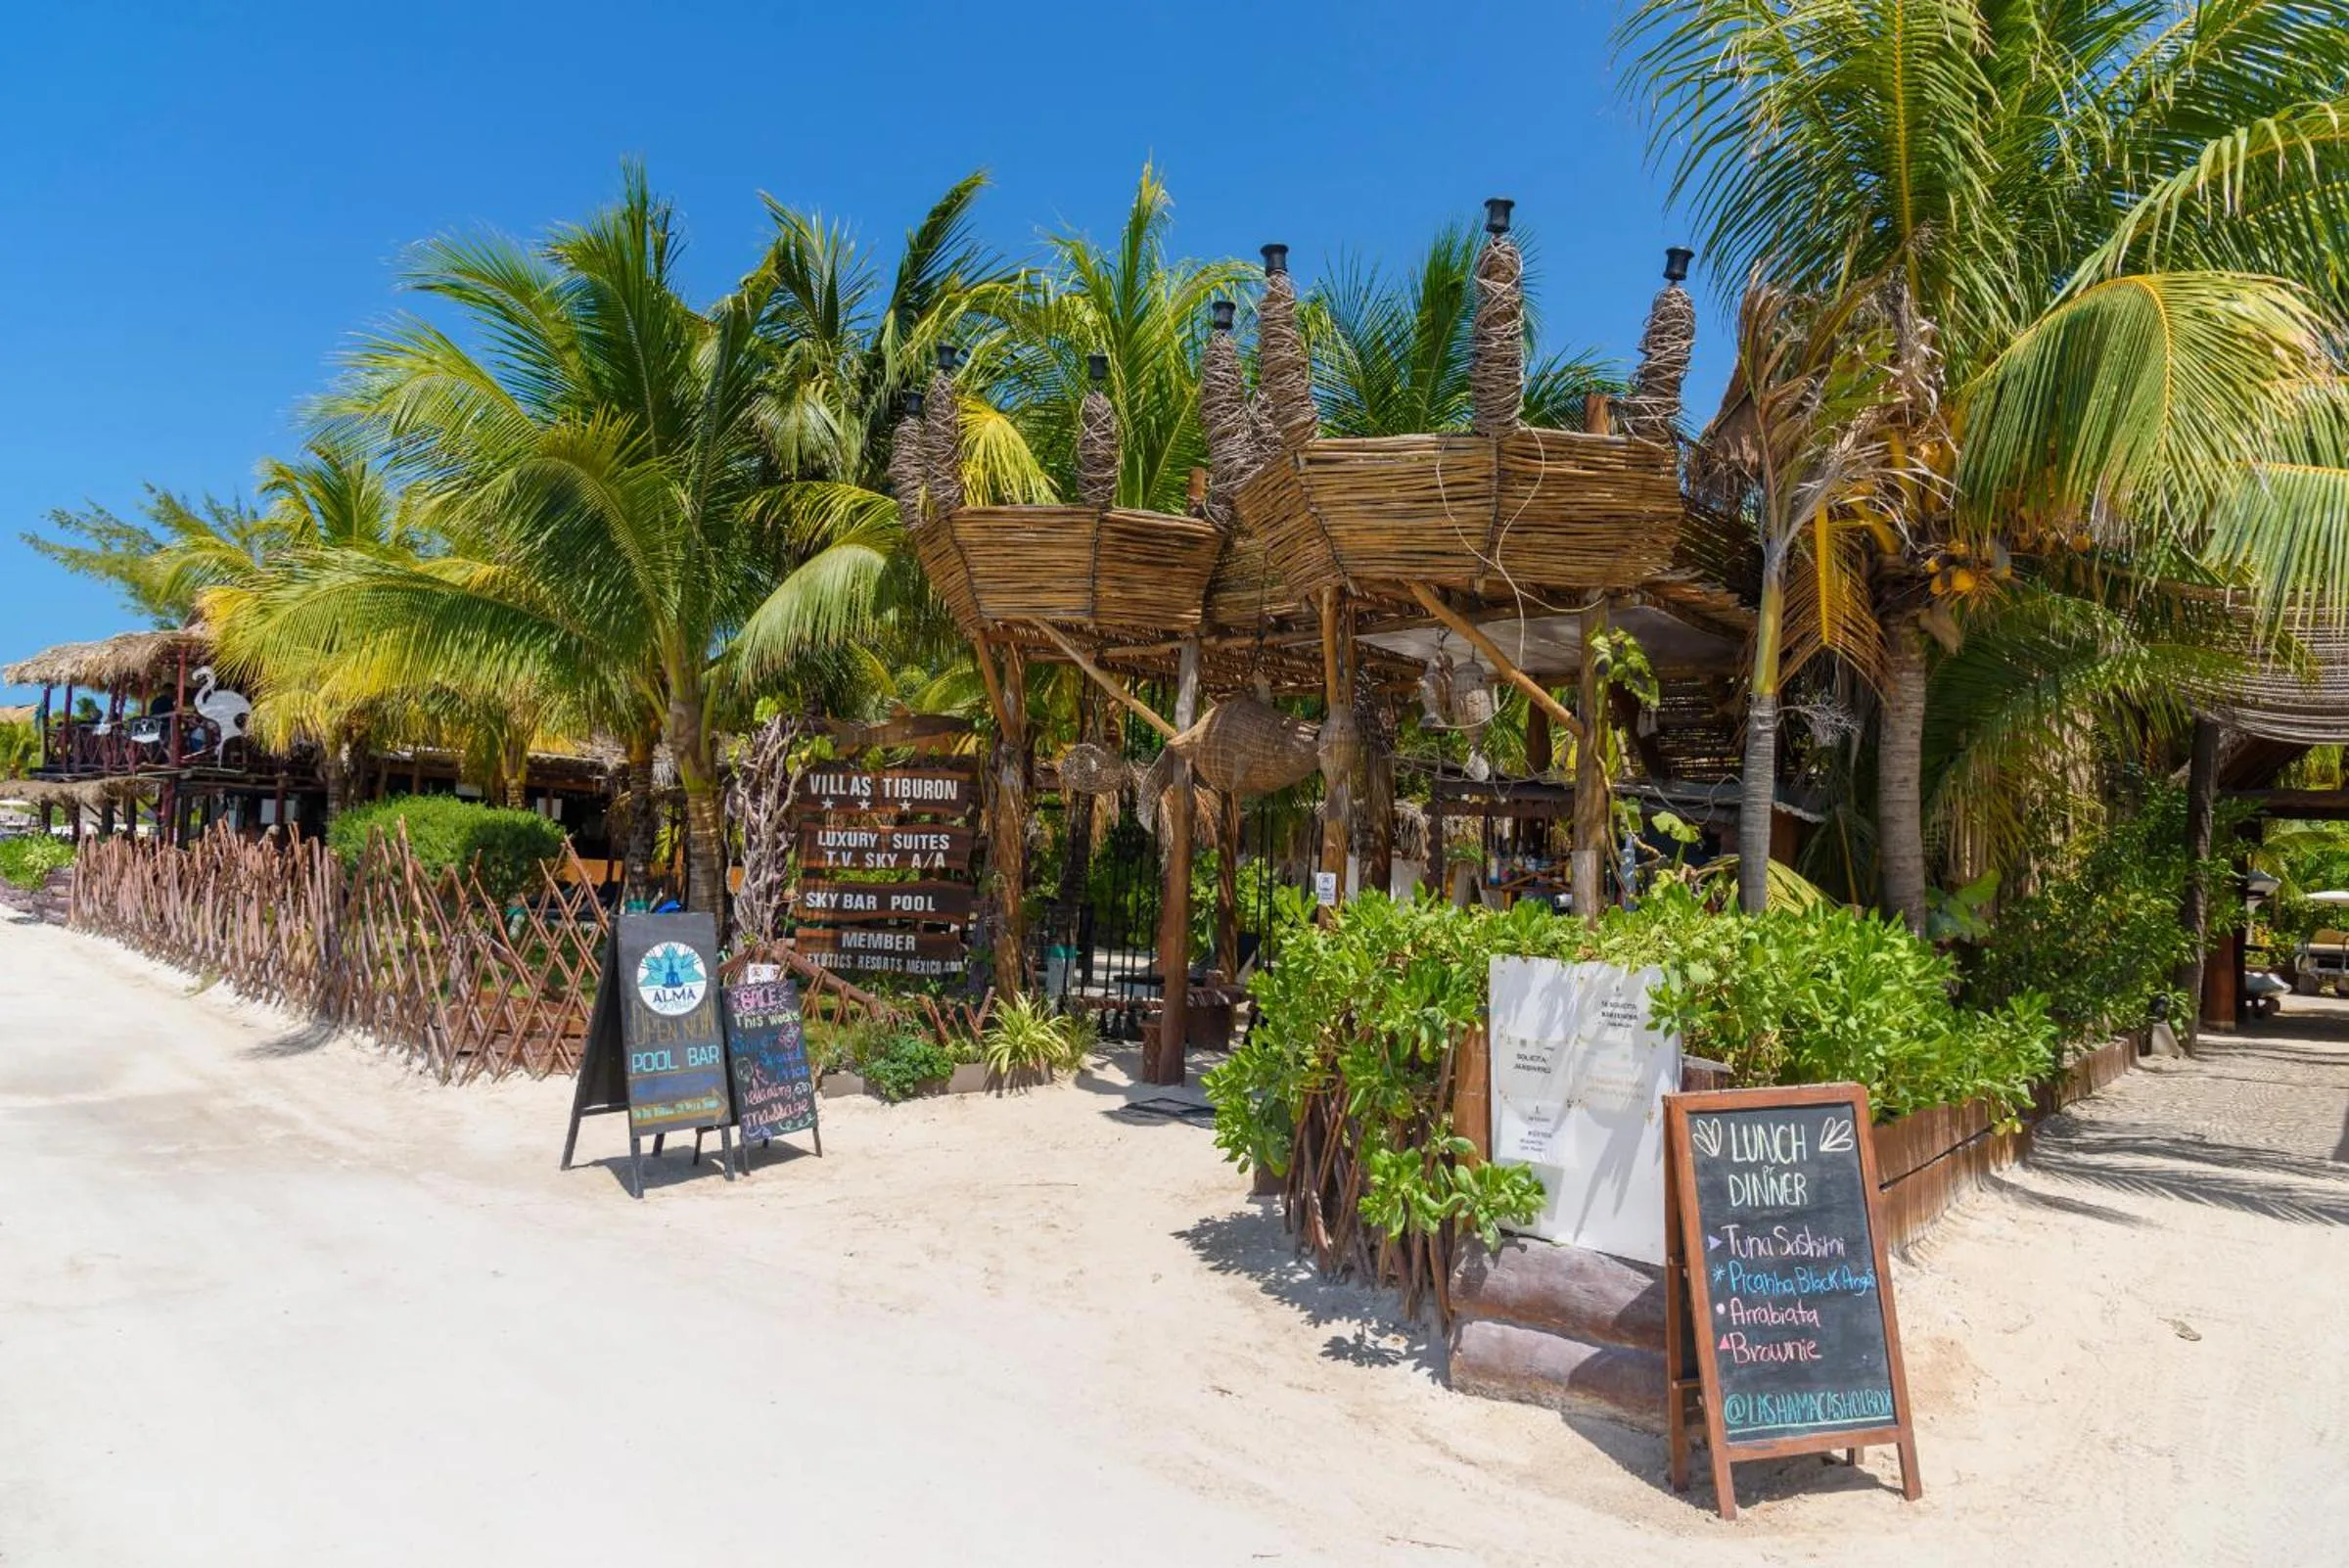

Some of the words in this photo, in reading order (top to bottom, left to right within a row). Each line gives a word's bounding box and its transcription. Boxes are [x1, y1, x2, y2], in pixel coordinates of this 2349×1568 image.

[809, 774, 872, 797] VILLAS
[883, 778, 958, 800] TIBURON
[817, 830, 879, 848] LUXURY
[893, 834, 950, 850] SUITES
[826, 851, 857, 866] T.V.
[865, 853, 898, 867] SKY
[911, 852, 946, 868] A/A
[806, 893, 839, 908] SKY
[843, 894, 878, 910] BAR
[891, 896, 936, 911] POOL
[842, 932, 916, 951] MEMBER
[857, 955, 902, 972] RESORTS
[653, 988, 696, 1003] ALMA
[733, 1013, 763, 1029] This
[631, 1049, 679, 1074] POOL
[687, 1044, 720, 1067] BAR
[1729, 1122, 1807, 1164] LUNCH
[1728, 1173, 1808, 1207] DINNER
[1721, 1224, 1773, 1259] Tuna
[1729, 1297, 1820, 1328] Arrabiata
[1729, 1331, 1822, 1364] Brownie
